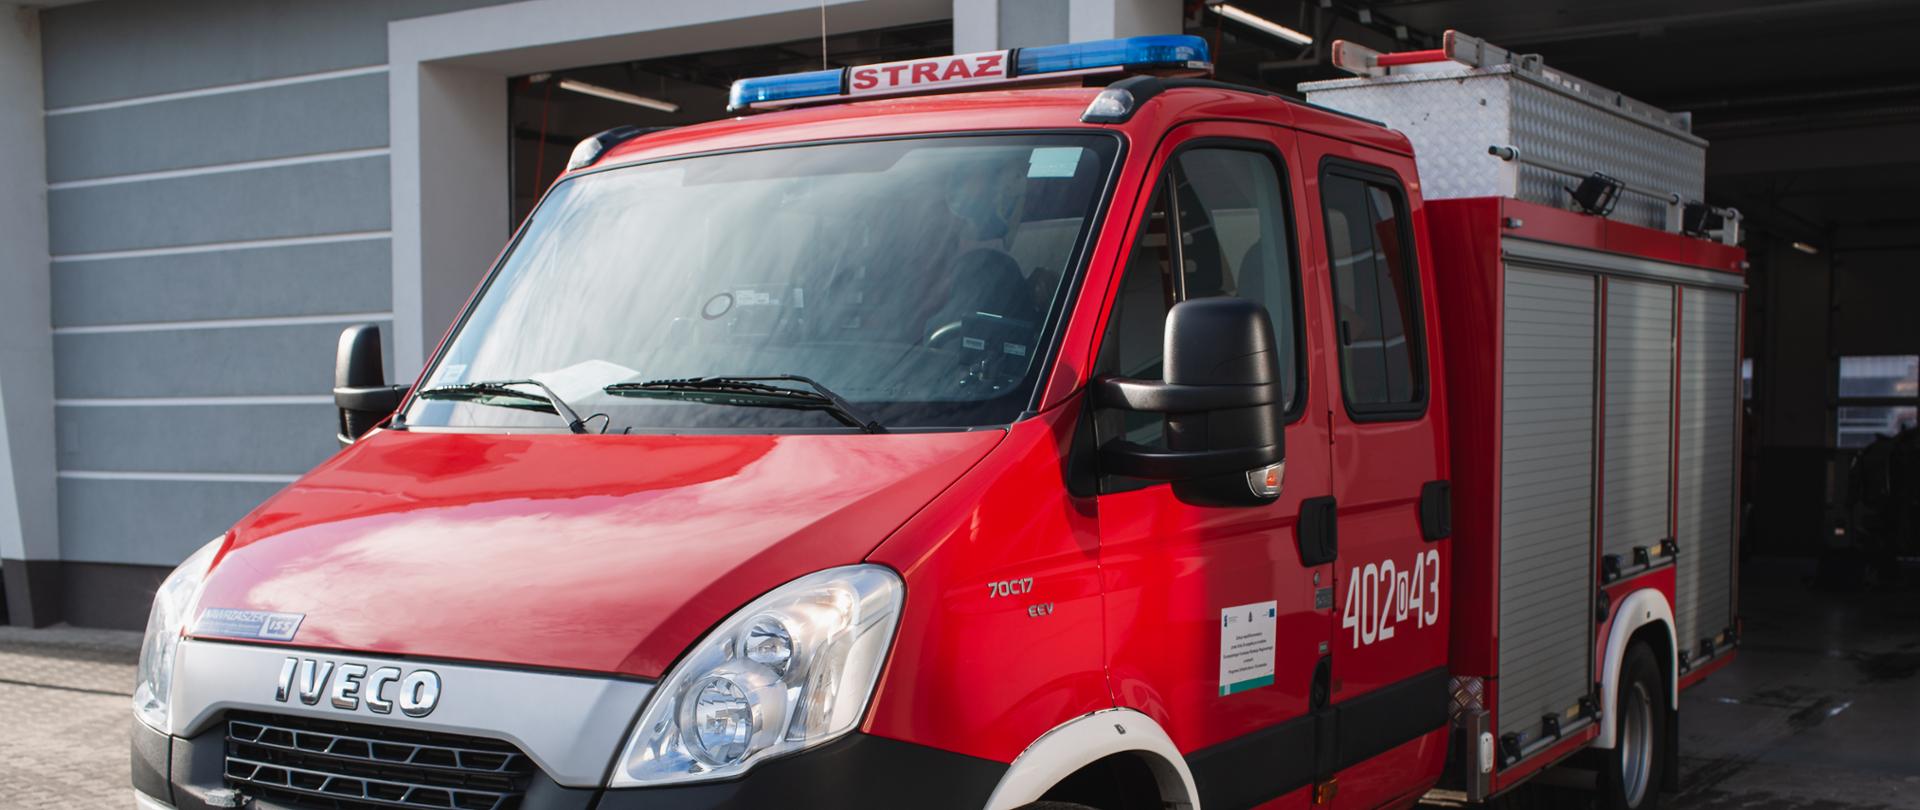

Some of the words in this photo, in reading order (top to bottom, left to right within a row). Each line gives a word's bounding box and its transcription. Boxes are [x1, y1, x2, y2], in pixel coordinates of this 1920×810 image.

[987, 577, 1033, 598] 70C17
[1028, 602, 1054, 617] EEV
[275, 656, 441, 718] IVECO
